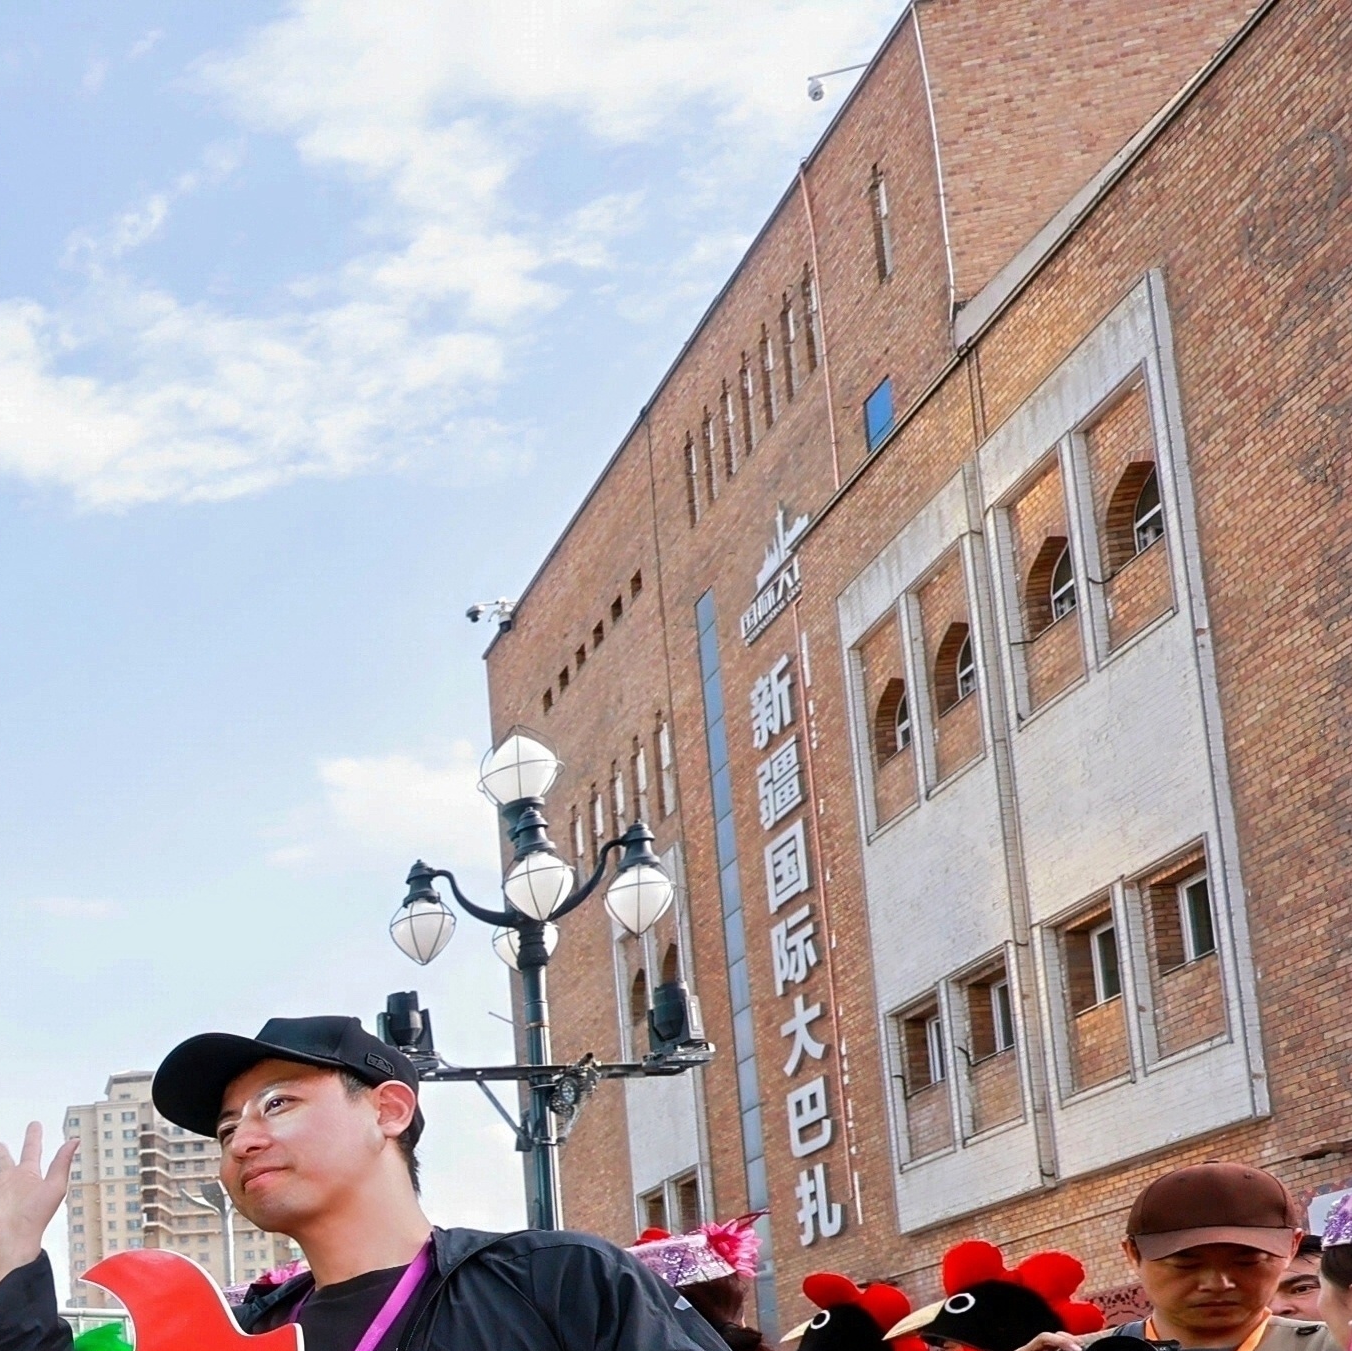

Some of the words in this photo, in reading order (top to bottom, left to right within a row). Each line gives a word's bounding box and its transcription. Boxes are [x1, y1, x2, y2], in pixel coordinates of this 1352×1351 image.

[740, 555, 801, 639] 国际大
[748, 652, 844, 1247] 新疆国际大巴扎
